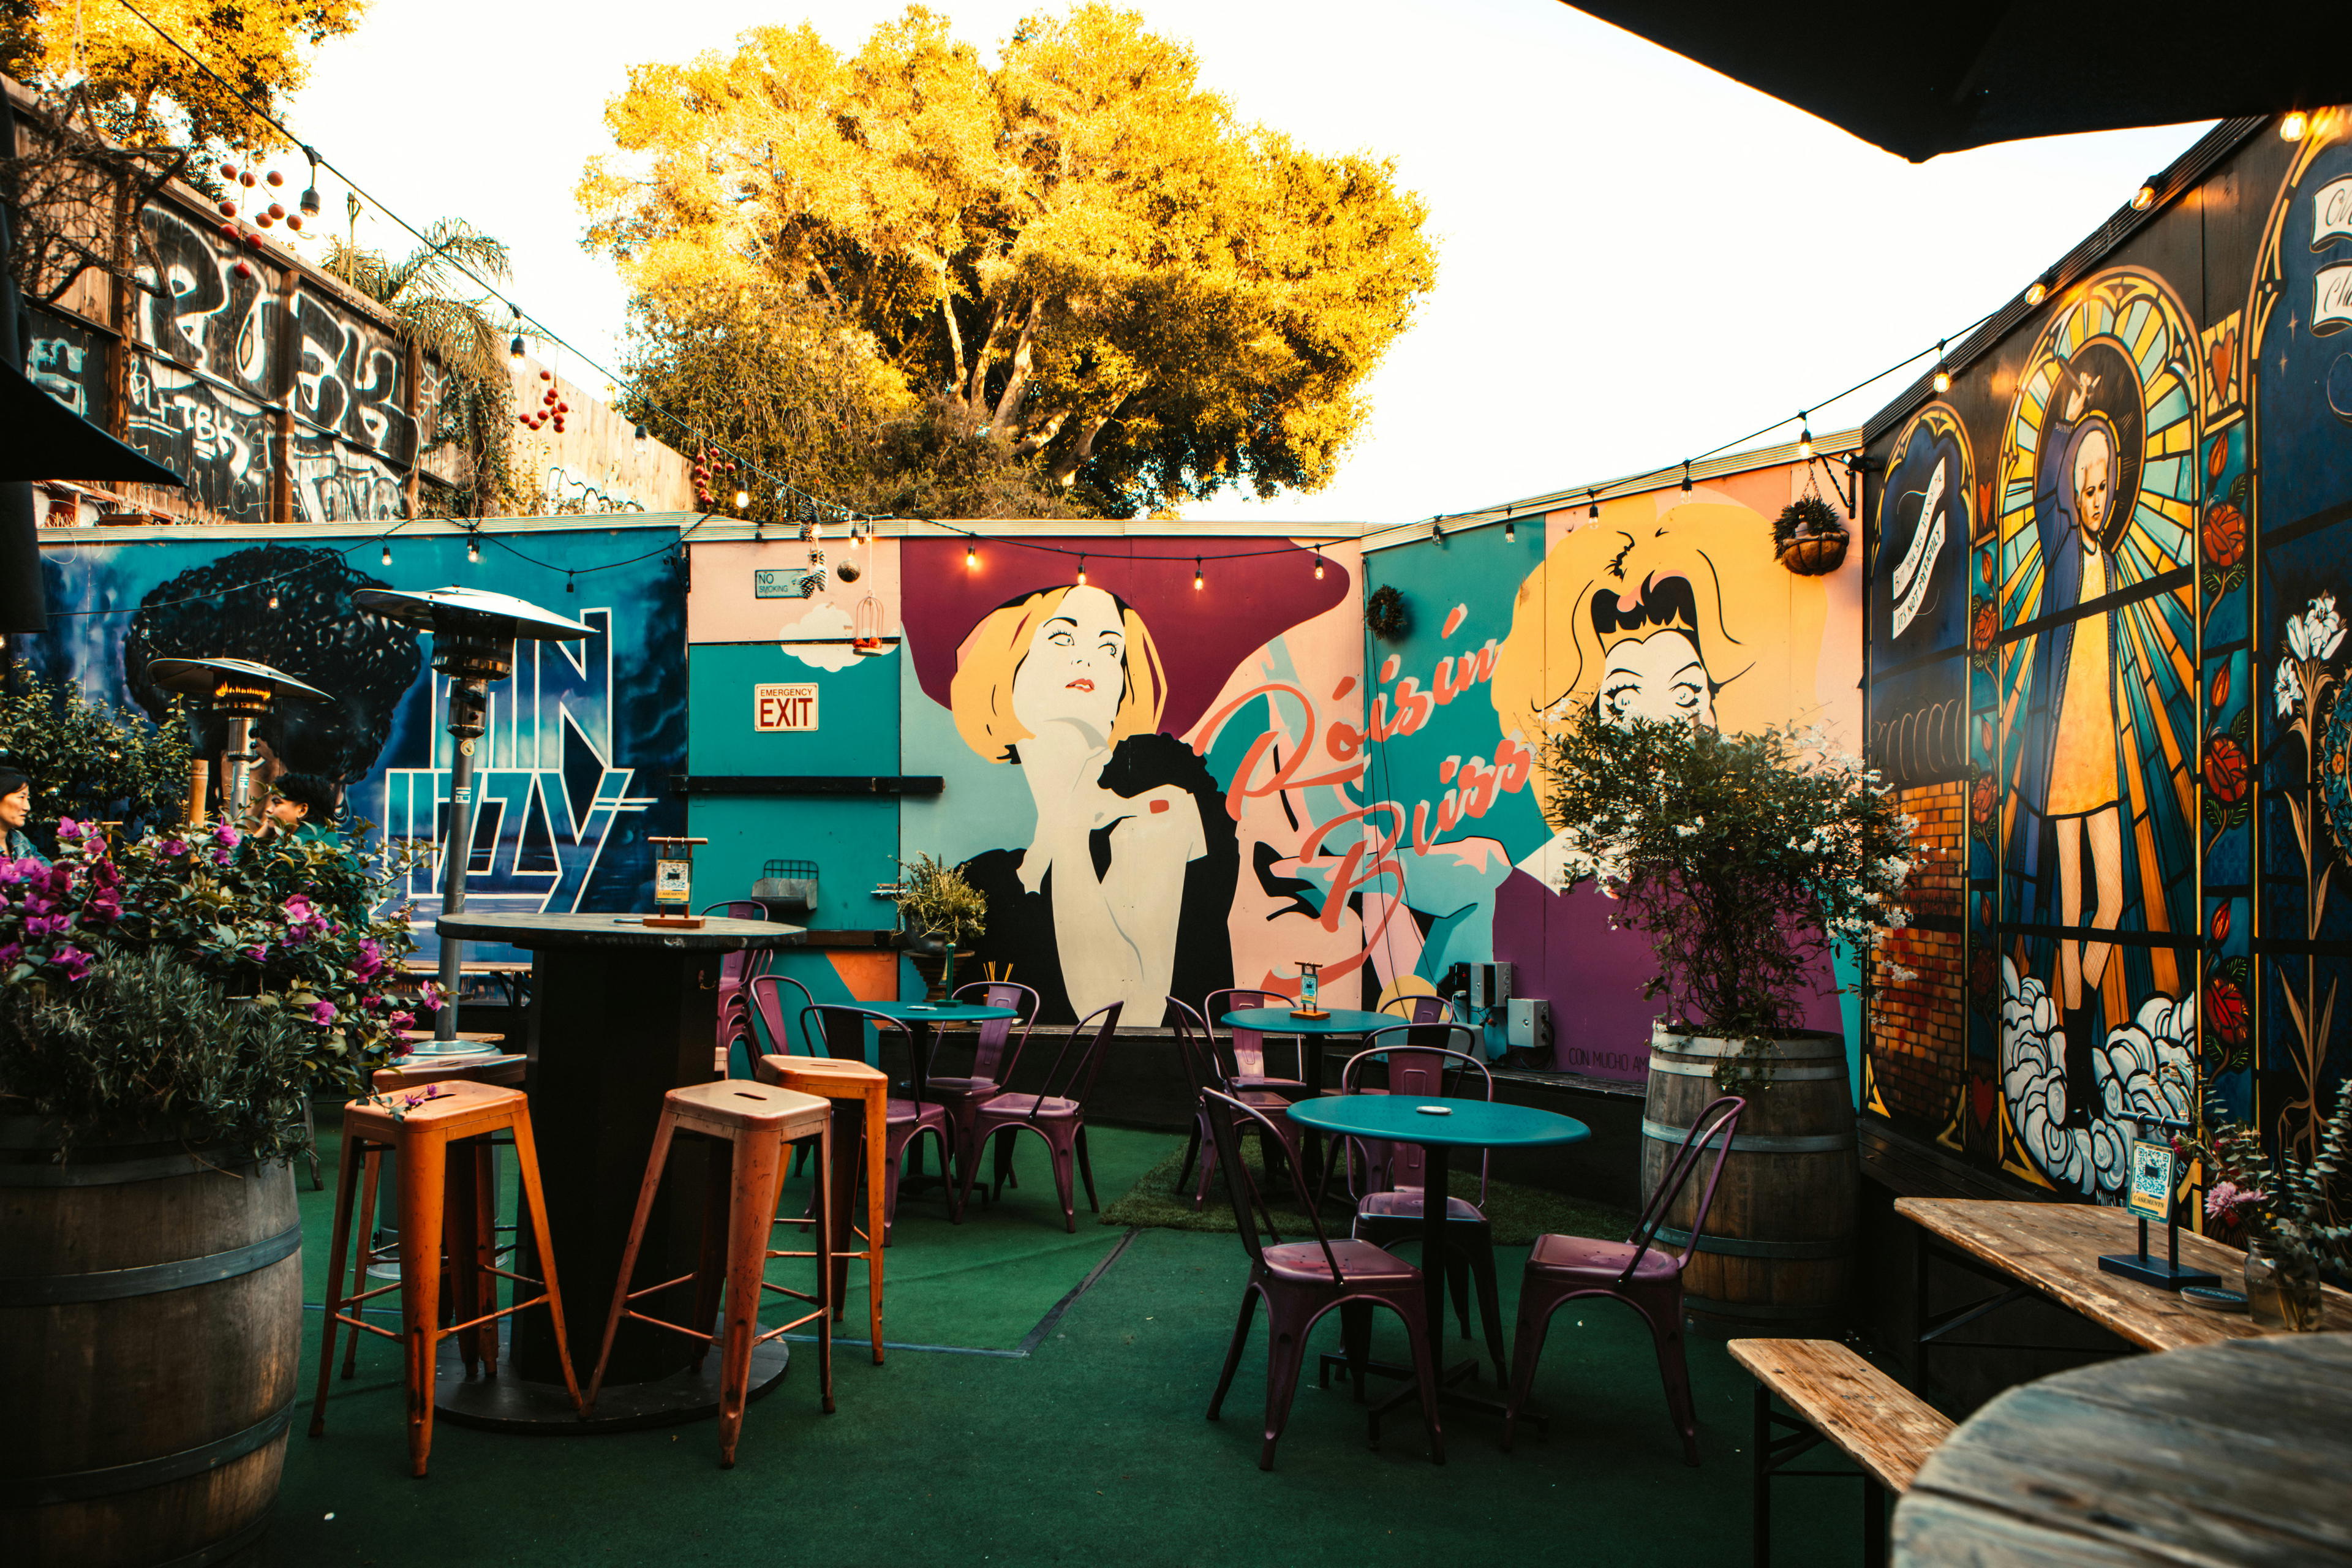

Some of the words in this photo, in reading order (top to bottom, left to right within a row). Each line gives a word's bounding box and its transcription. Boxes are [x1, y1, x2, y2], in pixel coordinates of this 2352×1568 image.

[759, 573, 774, 584] NO
[1907, 589, 1919, 615] NOT
[1923, 527, 1941, 571] FAMILY
[760, 688, 813, 697] EMERGENCY
[760, 698, 813, 727] EXIT
[1569, 1047, 1590, 1066] CON
[1593, 1051, 1629, 1071] MUCHO
[1632, 1055, 1650, 1073] AM
[2133, 1195, 2165, 1208] CASEMENTS
